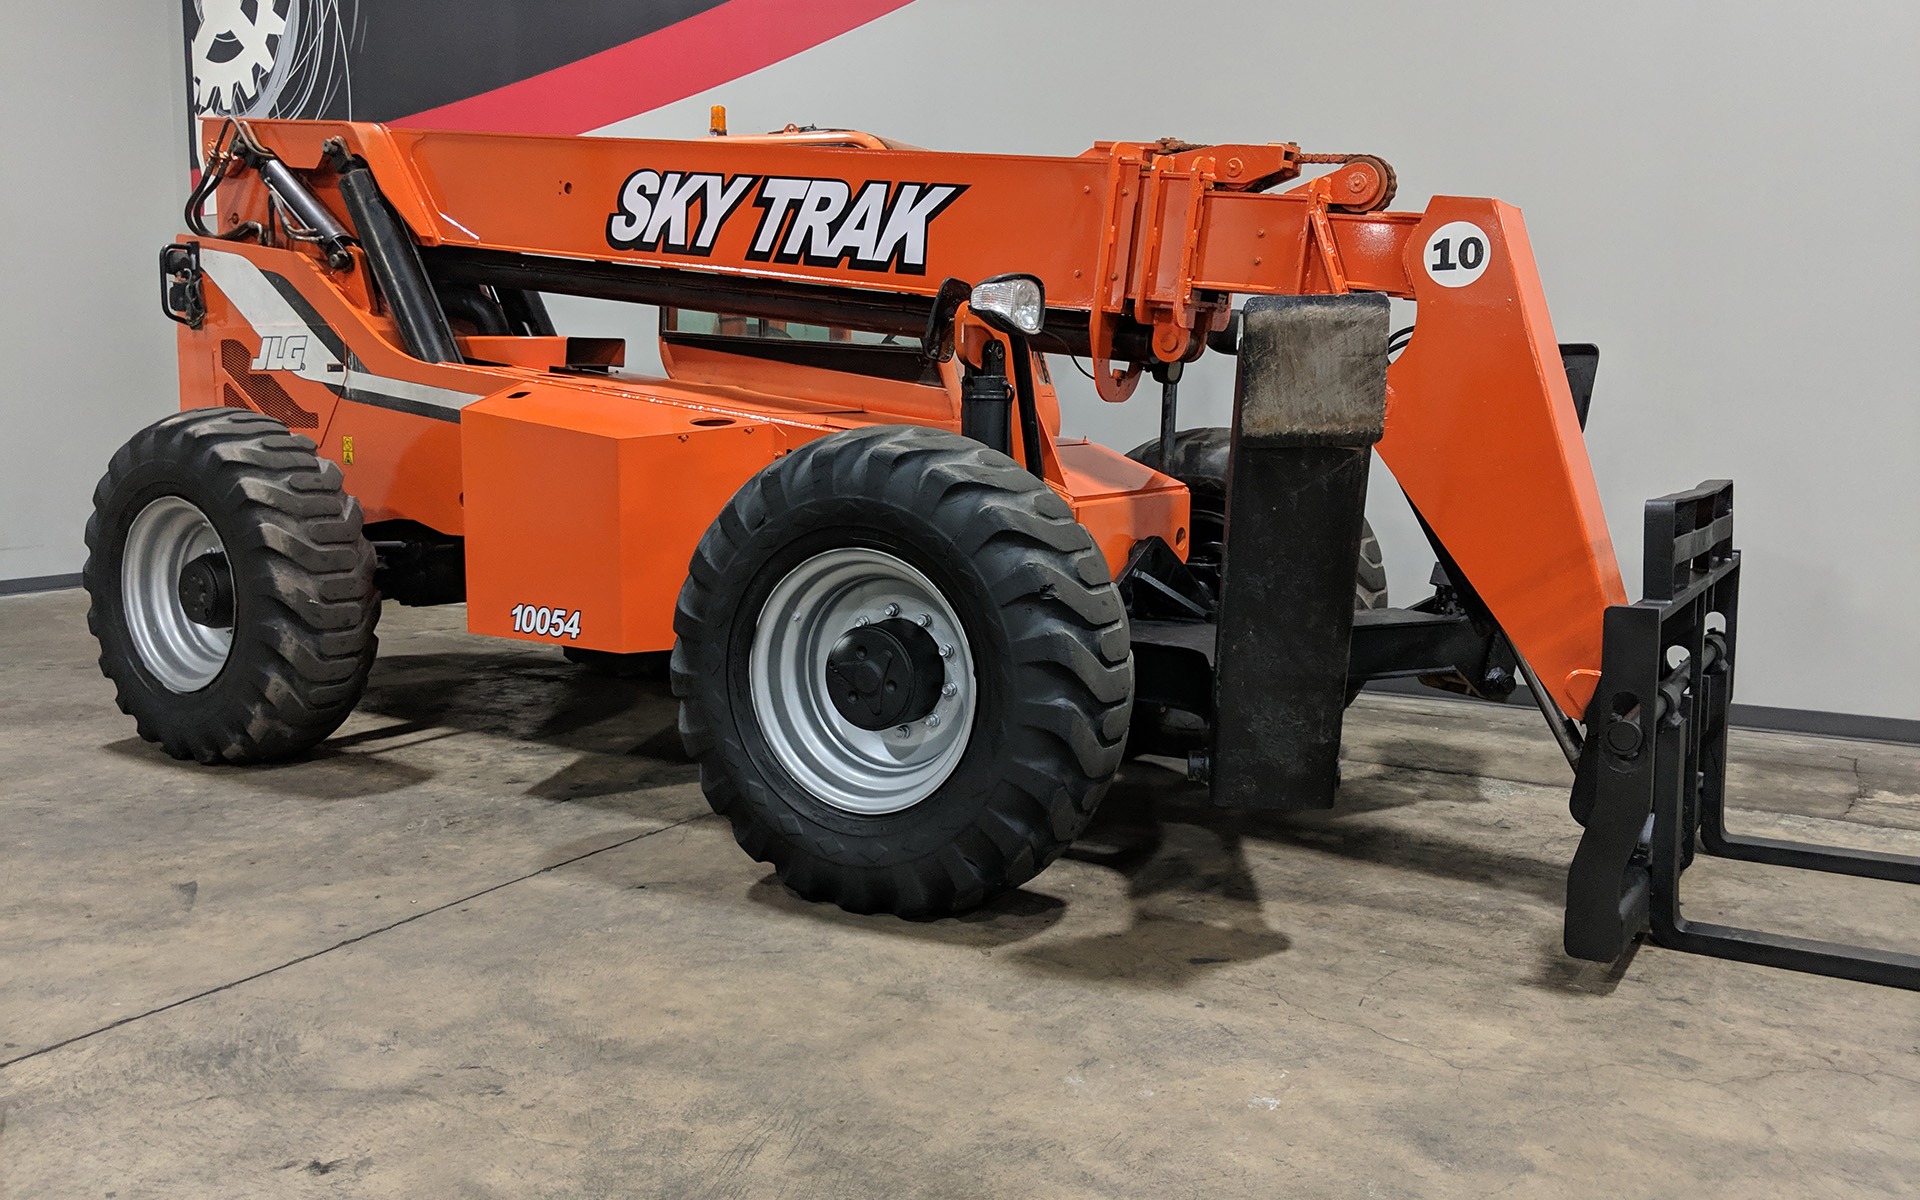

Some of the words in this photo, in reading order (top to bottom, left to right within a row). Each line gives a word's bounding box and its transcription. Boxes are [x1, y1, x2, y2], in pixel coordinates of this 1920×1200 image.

[607, 168, 762, 257] SKY
[746, 174, 970, 276] TRAK
[1432, 236, 1484, 271] 10
[250, 335, 308, 371] JLG
[511, 603, 581, 639] 10054
